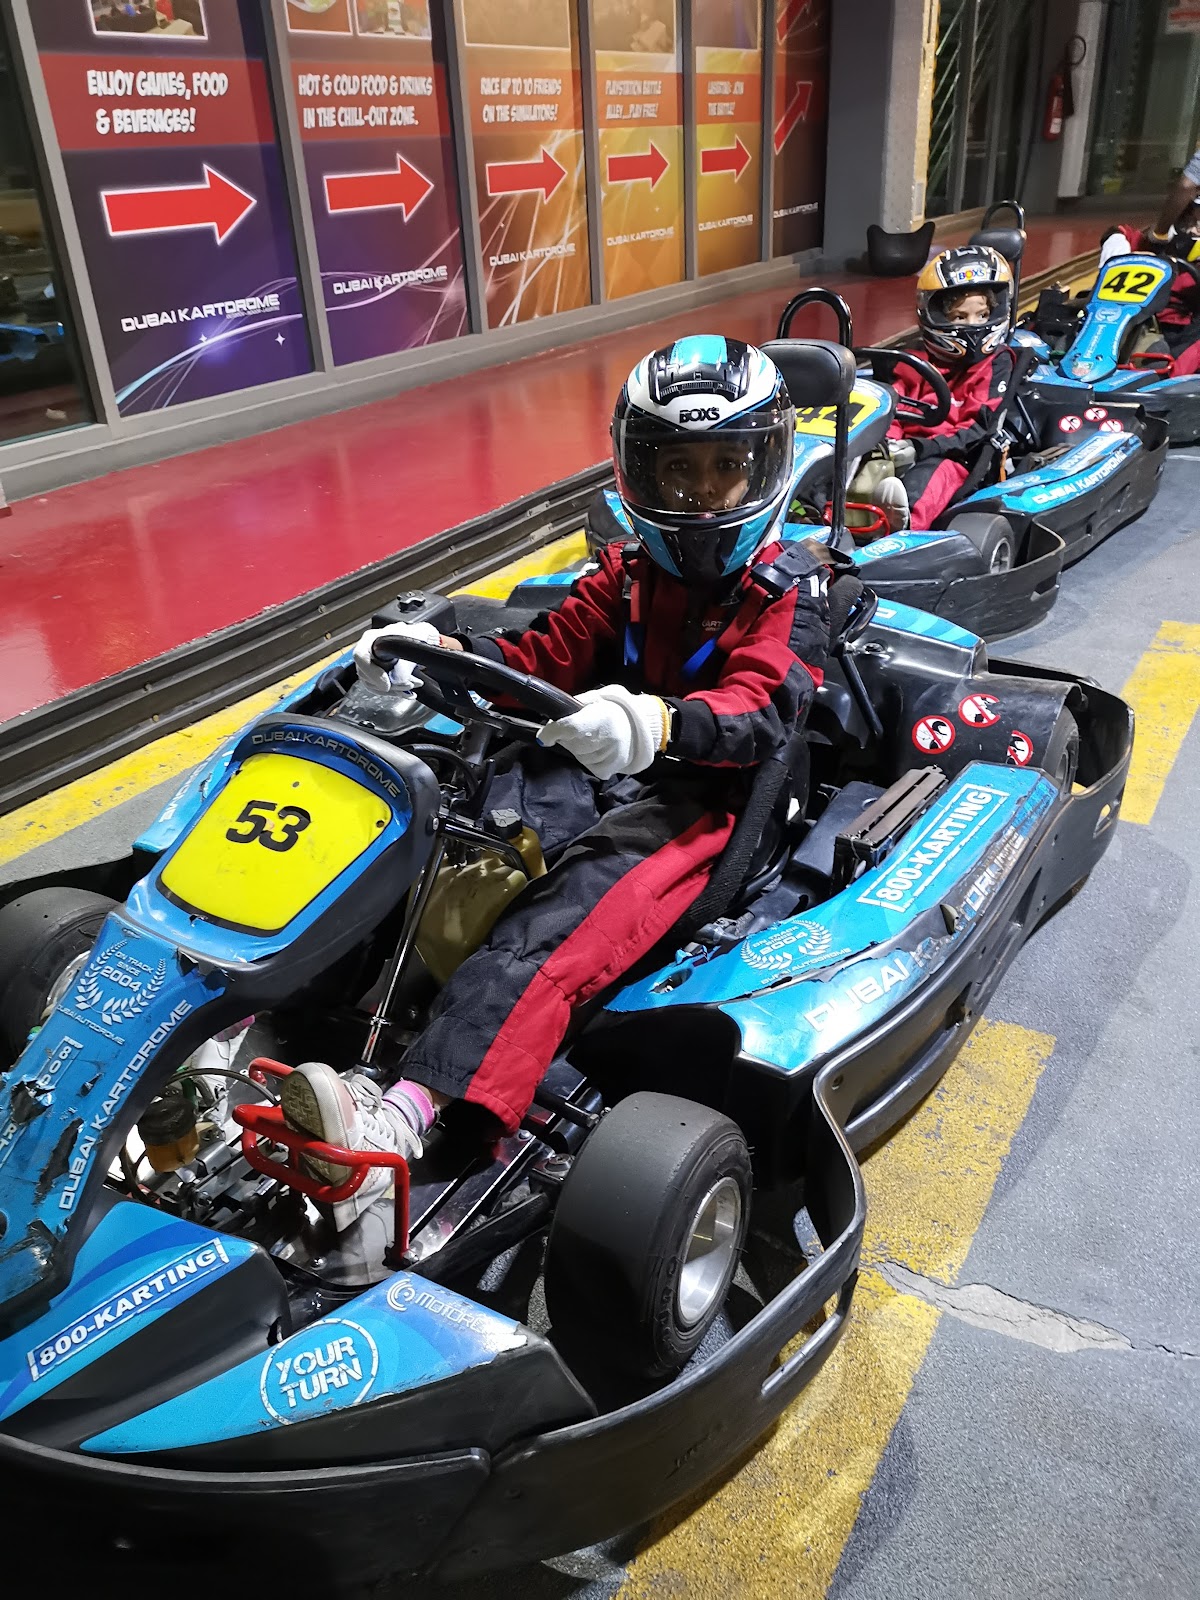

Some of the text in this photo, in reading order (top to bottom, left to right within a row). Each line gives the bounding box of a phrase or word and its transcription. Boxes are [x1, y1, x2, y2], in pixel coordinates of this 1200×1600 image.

[87, 70, 229, 100] ENJOY GAMES, FOOD
[298, 73, 433, 97] HOT & COLD FOOD & DRINKS
[511, 77, 523, 96] TO
[95, 107, 196, 135] & BEVERAGES!
[303, 105, 419, 129] IN THE CHILL-OUT ZONE.
[482, 104, 495, 123] ON
[496, 105, 510, 122] THE
[607, 234, 630, 246] DUBAI
[489, 253, 519, 267] DUBAI
[519, 243, 576, 261] KARTDROME
[333, 278, 373, 295] DUBAI
[374, 265, 448, 288] KARTDROME
[1103, 271, 1155, 296] 42
[120, 311, 176, 332] DUBAI
[178, 294, 280, 322] KARTDROME
[1031, 482, 1078, 504] DUBAI
[302, 732, 402, 798] KARTDROME
[225, 799, 312, 853] 53
[875, 790, 994, 902] 800-KARTING
[759, 931, 809, 956] 2004
[114, 951, 154, 974] ON TRACK
[116, 961, 141, 977] SINCE
[791, 947, 852, 971] AUTODROME
[100, 965, 142, 993] 2004
[75, 1013, 125, 1045] AUTODROME
[59, 999, 193, 1210] DUBAI KARTDROME
[39, 1249, 217, 1366] 800-KARTING
[276, 1336, 357, 1385] YOUR
[281, 1357, 363, 1408] TURN
